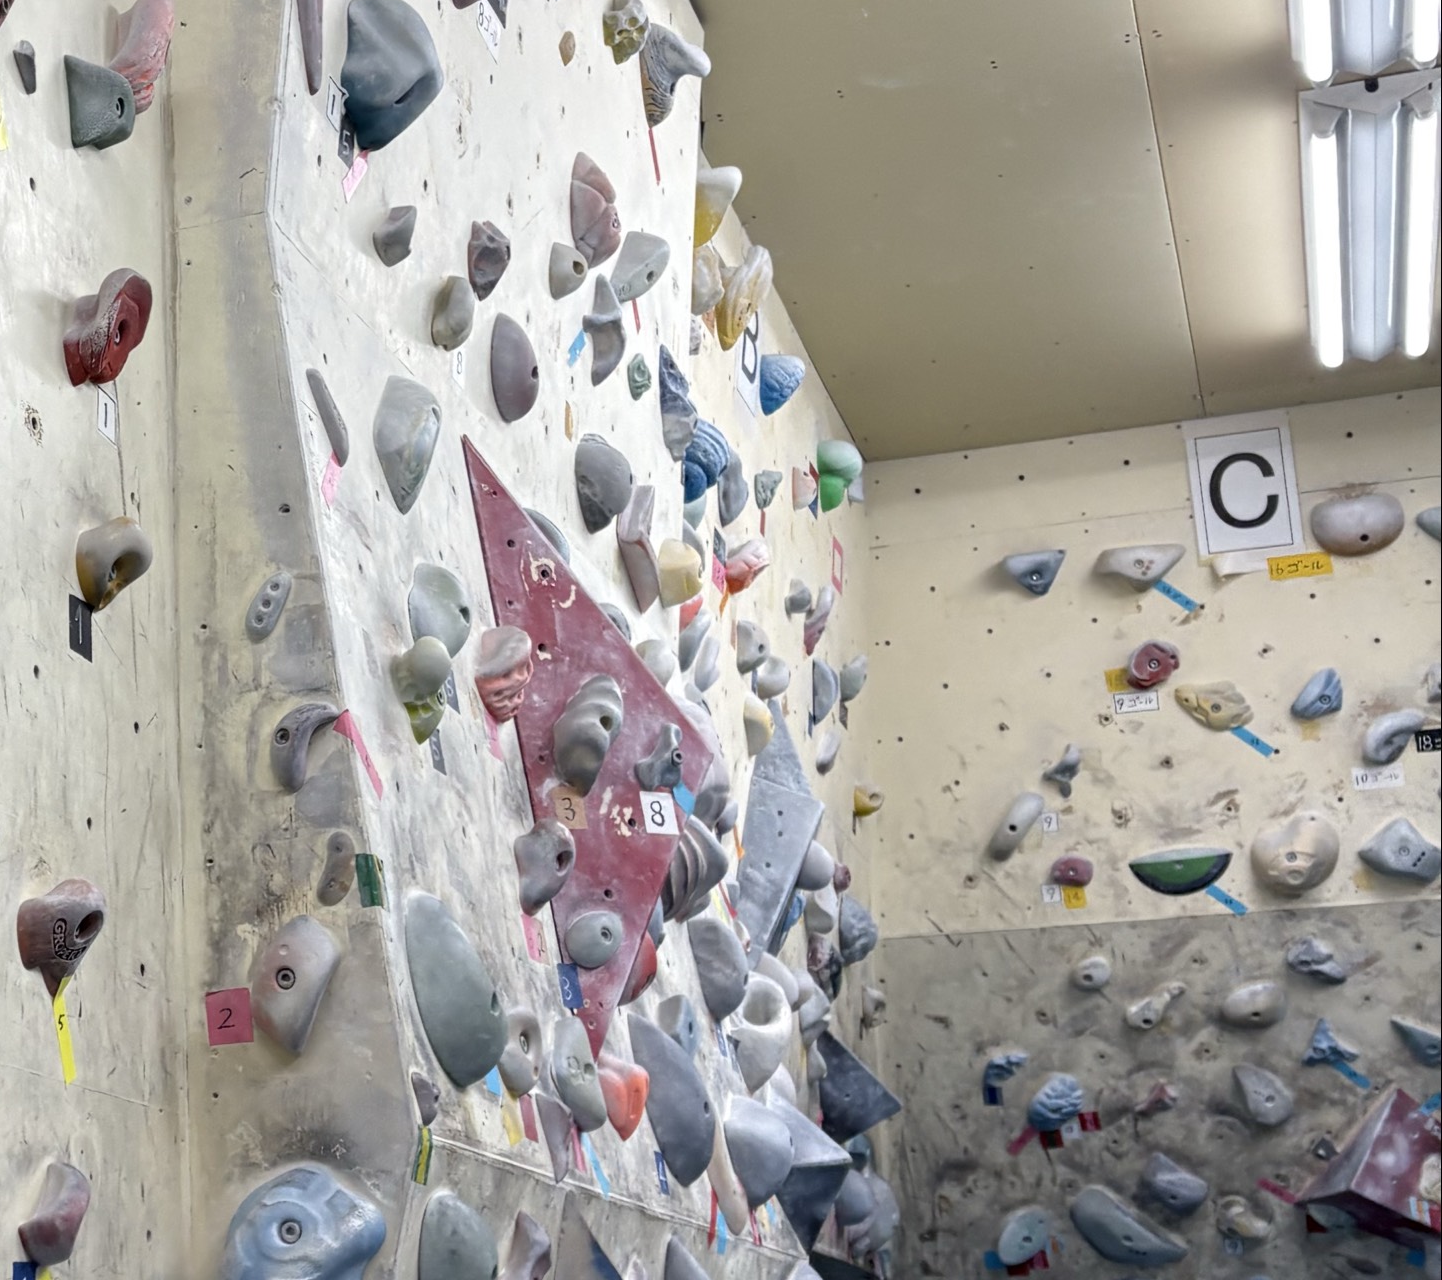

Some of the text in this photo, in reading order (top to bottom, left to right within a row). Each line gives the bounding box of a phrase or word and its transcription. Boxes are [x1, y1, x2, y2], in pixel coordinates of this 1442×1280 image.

[341, 129, 352, 157] 5
[741, 310, 760, 385] B
[456, 351, 463, 375] 8
[1209, 452, 1279, 529] C
[561, 797, 576, 822] 3
[649, 800, 666, 828] 8
[58, 1014, 66, 1031] 5
[217, 1007, 236, 1030] 2
